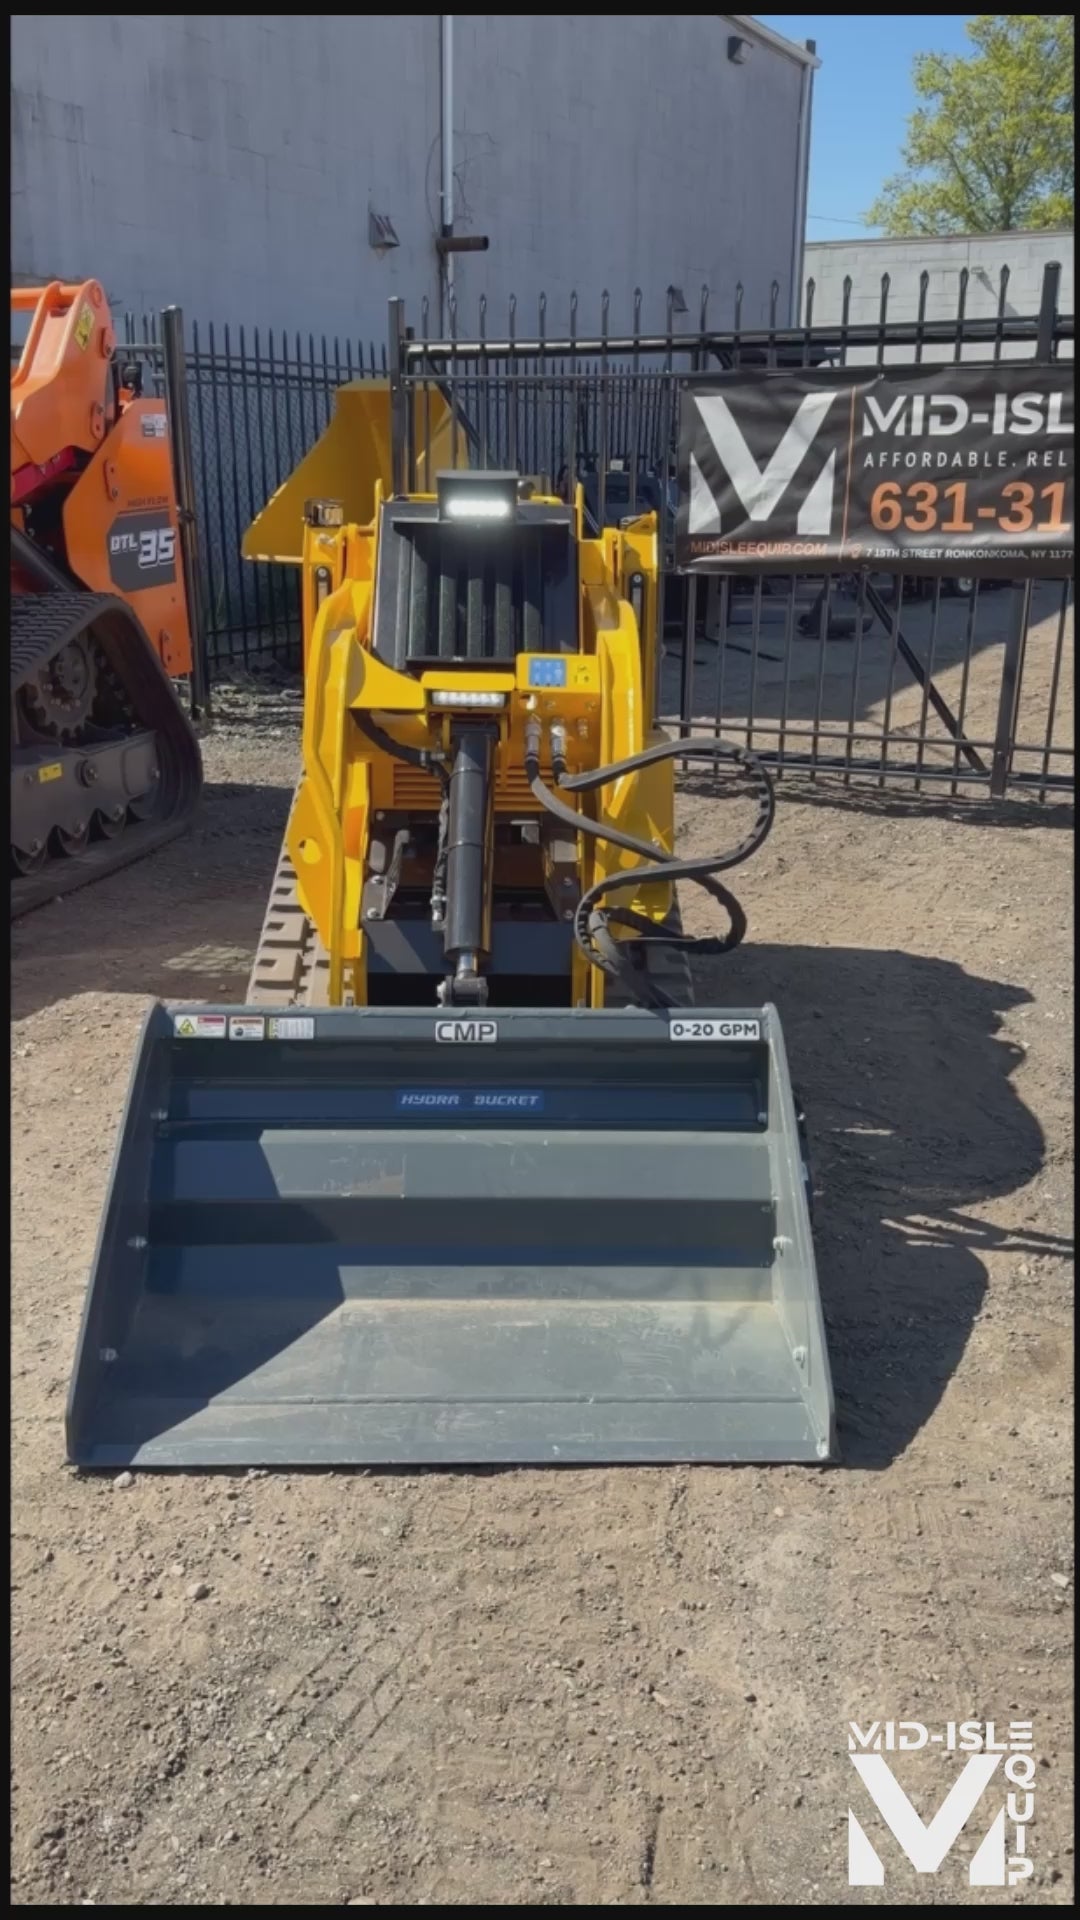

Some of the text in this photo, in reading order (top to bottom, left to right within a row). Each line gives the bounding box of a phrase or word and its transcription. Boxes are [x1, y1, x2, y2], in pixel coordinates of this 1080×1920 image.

[864, 452, 1016, 468] AFFORDABLE.
[871, 481, 1071, 532] 631-31
[138, 528, 176, 568] 35
[902, 549, 942, 559] STREET
[1031, 550, 1046, 559] NY
[437, 1023, 495, 1041] CMP
[673, 1023, 757, 1036] 0-20 GPM
[401, 1094, 539, 1106] HYDRA BUCKET
